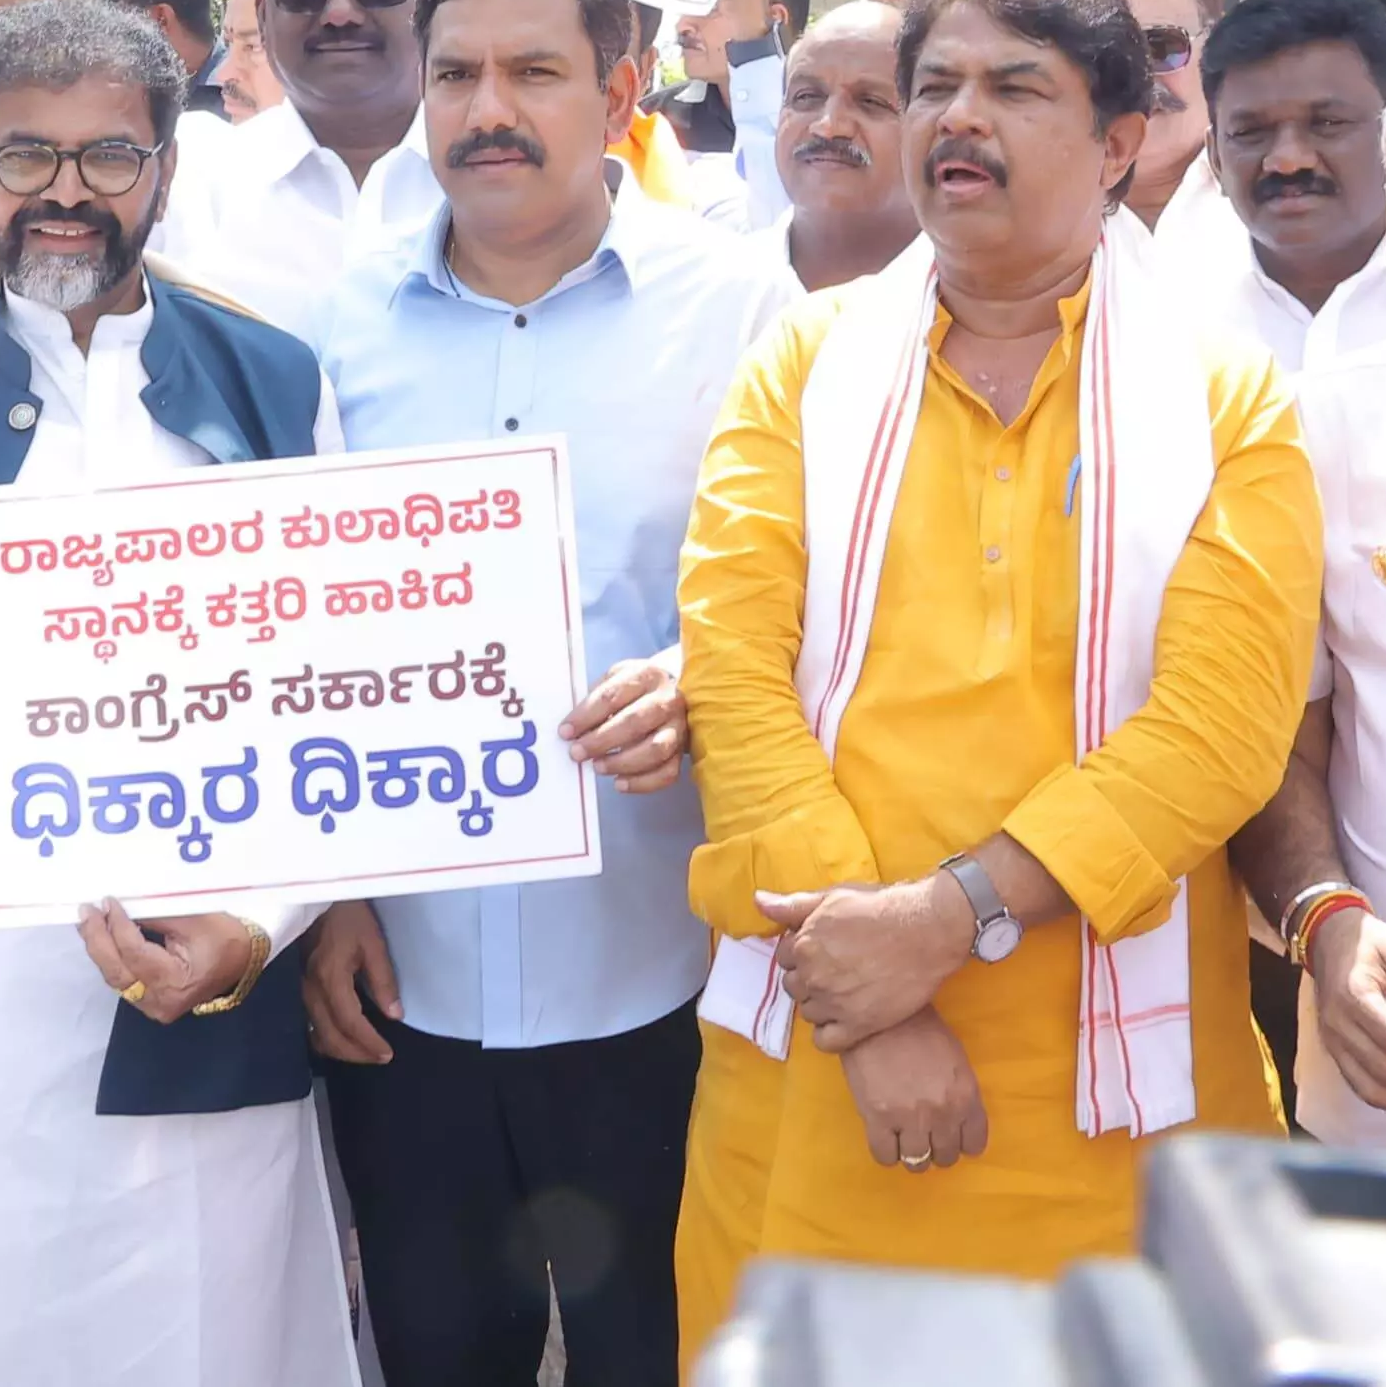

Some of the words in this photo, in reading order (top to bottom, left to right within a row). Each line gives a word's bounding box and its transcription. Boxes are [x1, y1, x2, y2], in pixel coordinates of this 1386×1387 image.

[0, 510, 264, 586] ರಾಜ್ಯಪಾಲರ
[281, 489, 522, 549] ಕುಲಾಧಿಪತಿ
[44, 584, 199, 664] ಸ್ಥಾನಕ್ಕೆ
[205, 577, 307, 644] ಕತ್ತರಿ
[324, 562, 473, 616] ಹಾಕಿದ
[26, 669, 252, 742] ಕಾಂಗ್ರೆಸ್
[271, 642, 524, 717] ಸರ್ಕಾರಕ್ಕೆ
[11, 746, 259, 863] ಧಿಕ್ಕಾರ
[289, 720, 539, 837] ಧಿಕ್ಕಾರ
